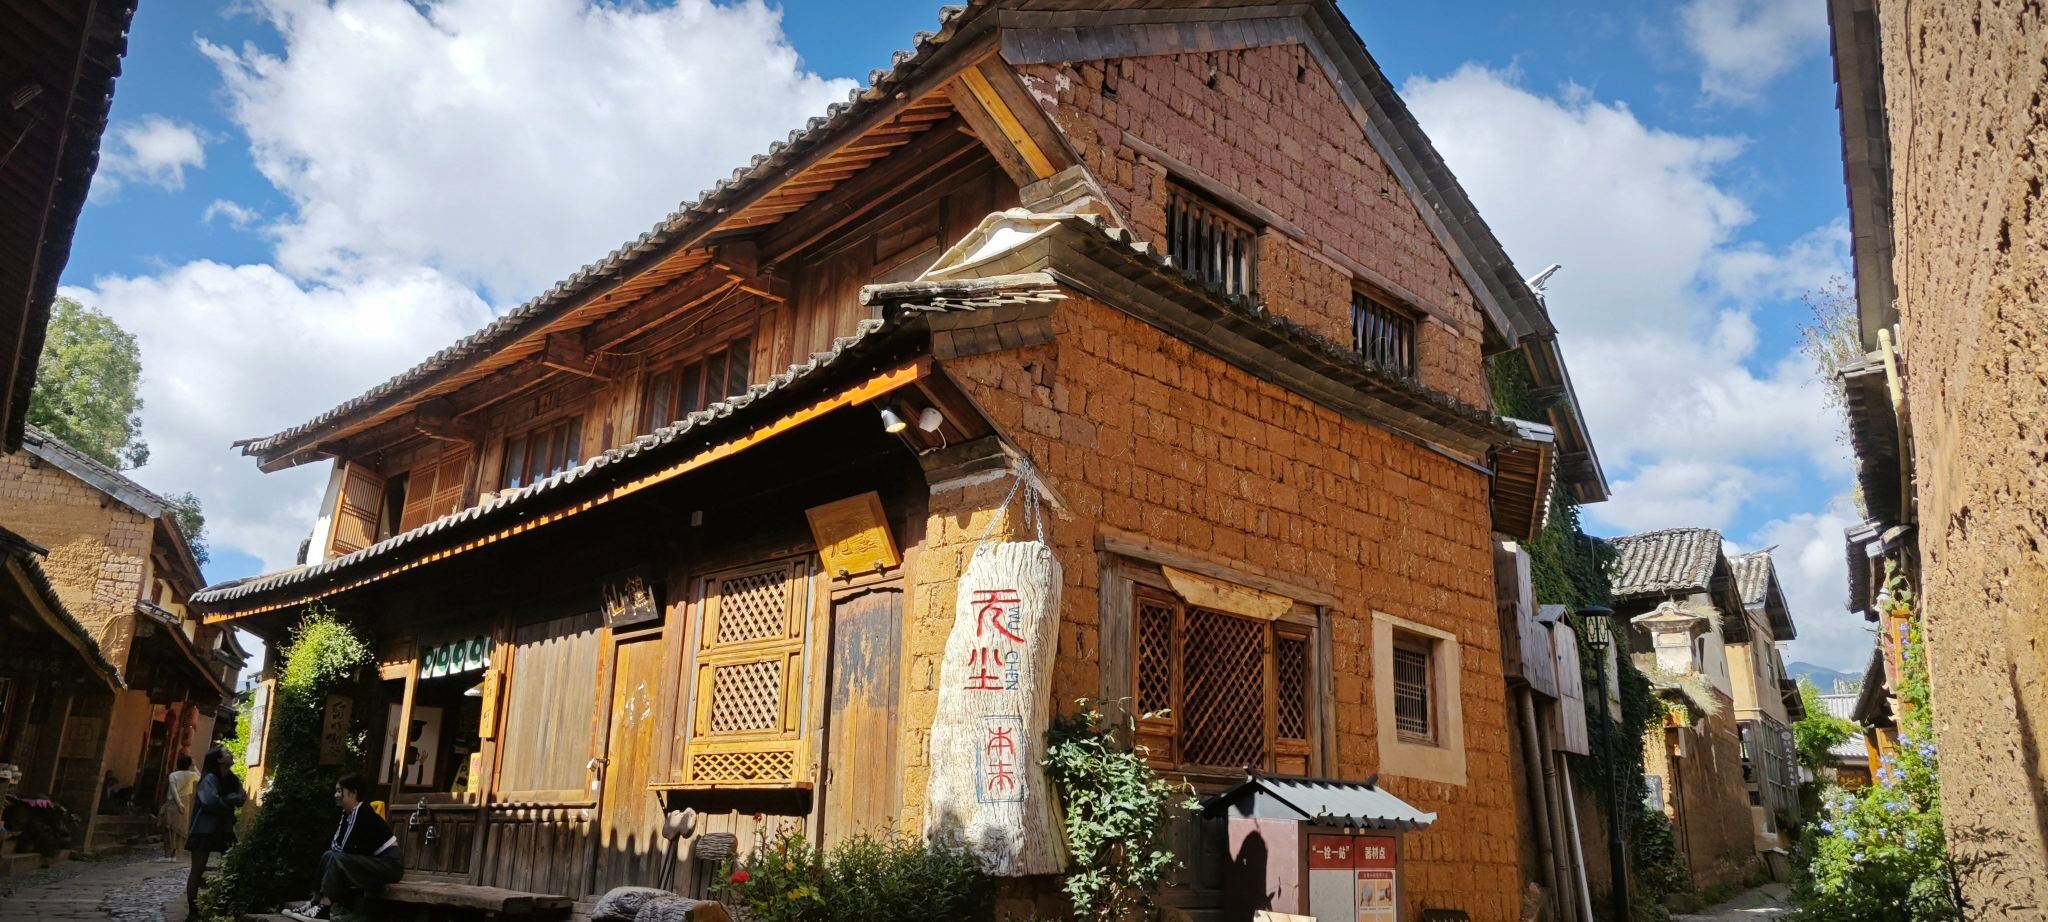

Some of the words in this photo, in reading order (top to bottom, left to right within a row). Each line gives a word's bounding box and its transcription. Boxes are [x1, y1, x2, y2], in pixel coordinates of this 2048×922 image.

[1008, 606, 1020, 631] WU
[1004, 650, 1019, 690] CHEN
[1364, 846, 1386, 860] 器材点
